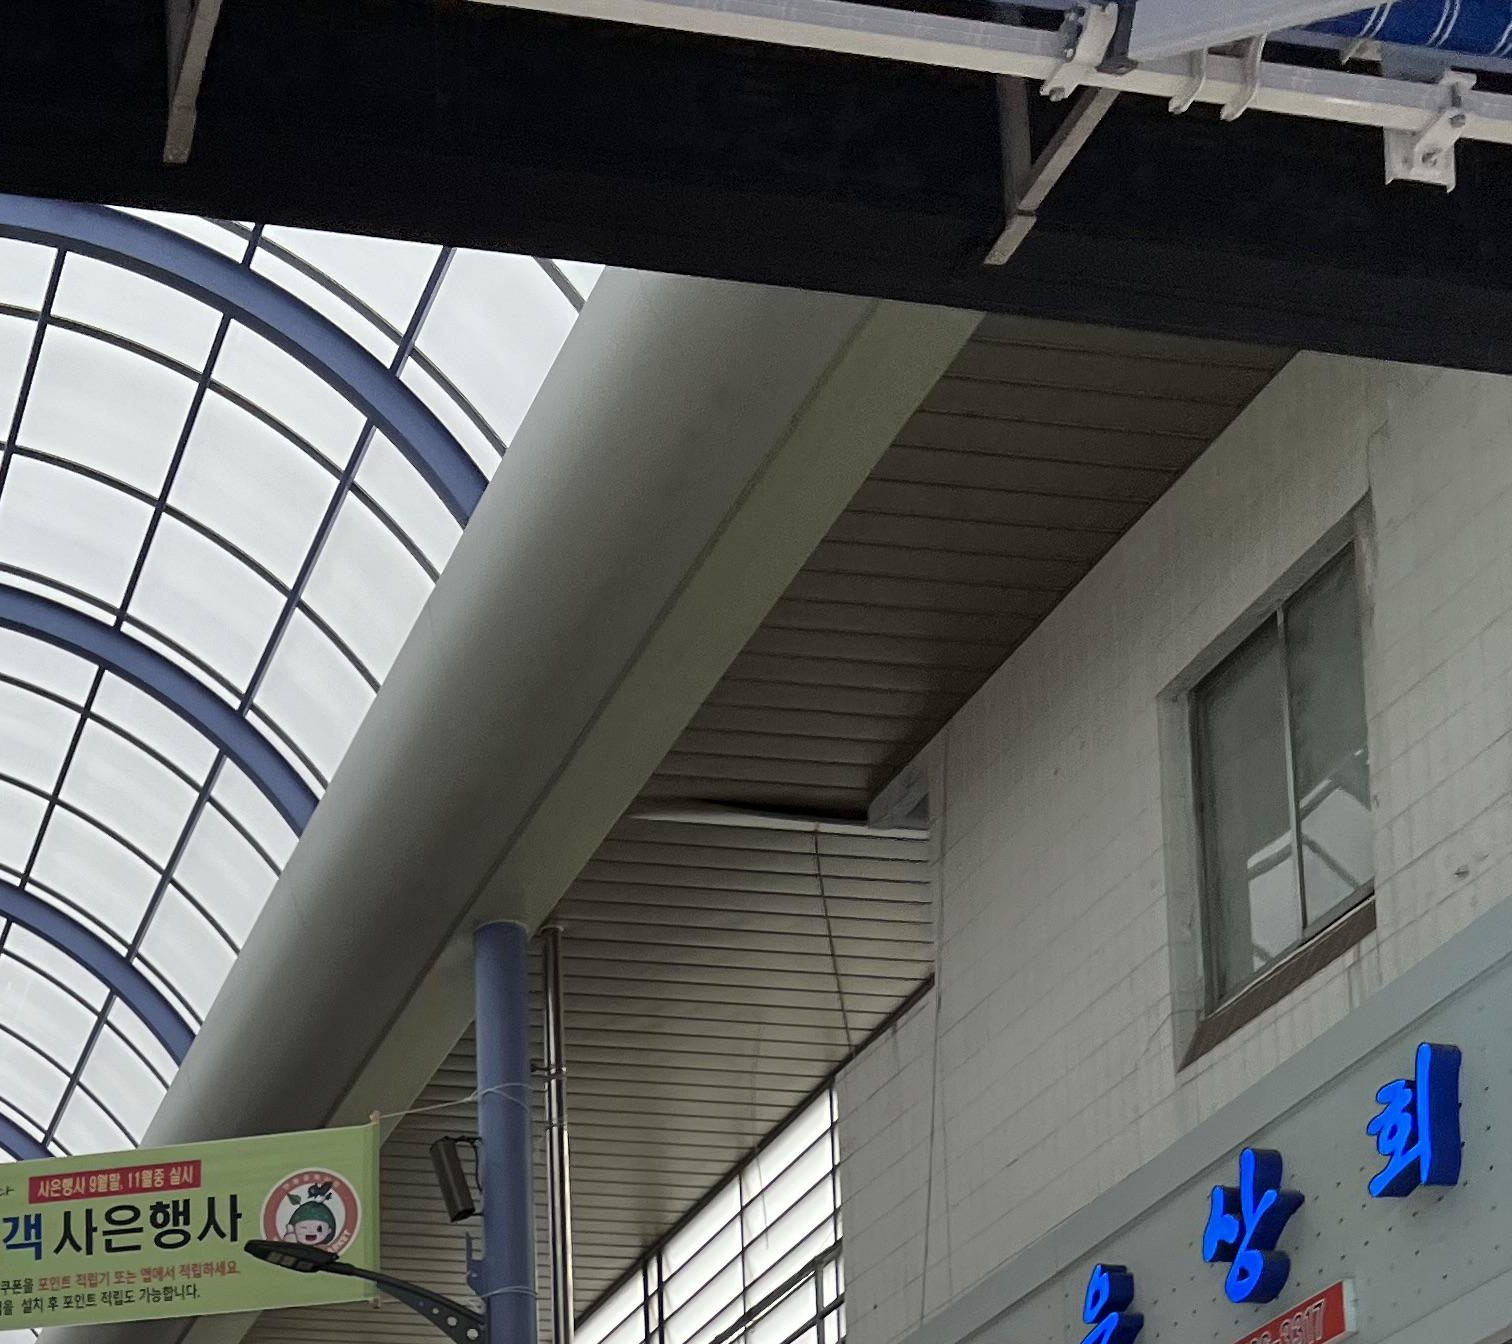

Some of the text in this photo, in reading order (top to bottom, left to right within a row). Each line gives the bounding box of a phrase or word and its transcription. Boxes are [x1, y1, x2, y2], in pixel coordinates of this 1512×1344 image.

[38, 1176, 86, 1198] 사은행사
[169, 1165, 194, 1185] 실시
[53, 1194, 243, 1256] 사은행사
[0, 1277, 34, 1297] 쿠폰을
[38, 1275, 72, 1292] 포인트
[76, 1271, 110, 1289] 적립기
[113, 1269, 137, 1286] 또는
[140, 1265, 175, 1284] 앱에서
[21, 1294, 44, 1313] 설치
[47, 1294, 59, 1312] 후
[62, 1291, 97, 1310] 포인트
[100, 1288, 135, 1307] 적립도
